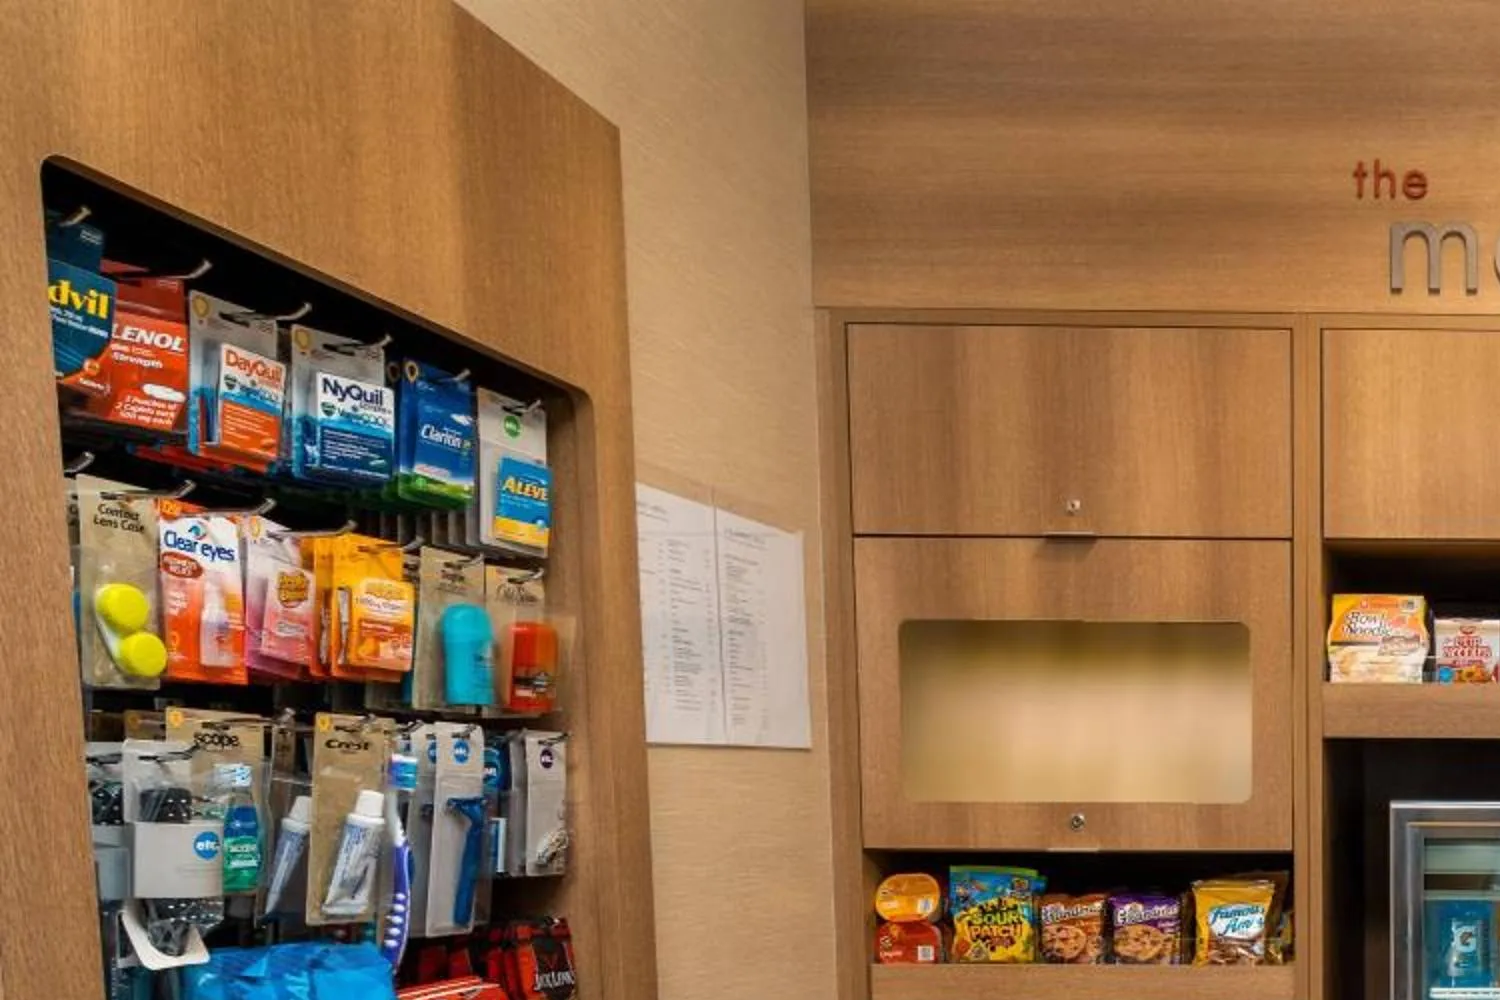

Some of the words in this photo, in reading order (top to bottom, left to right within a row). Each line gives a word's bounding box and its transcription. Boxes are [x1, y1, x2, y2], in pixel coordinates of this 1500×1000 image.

[1353, 159, 1428, 199] the
[49, 279, 109, 320] dvil
[112, 322, 185, 352] LENOL
[226, 350, 282, 381] DayQuil
[322, 377, 384, 402] NyQuil
[164, 530, 198, 552] Clear
[201, 544, 235, 562] eyes
[325, 738, 370, 751] Crest
